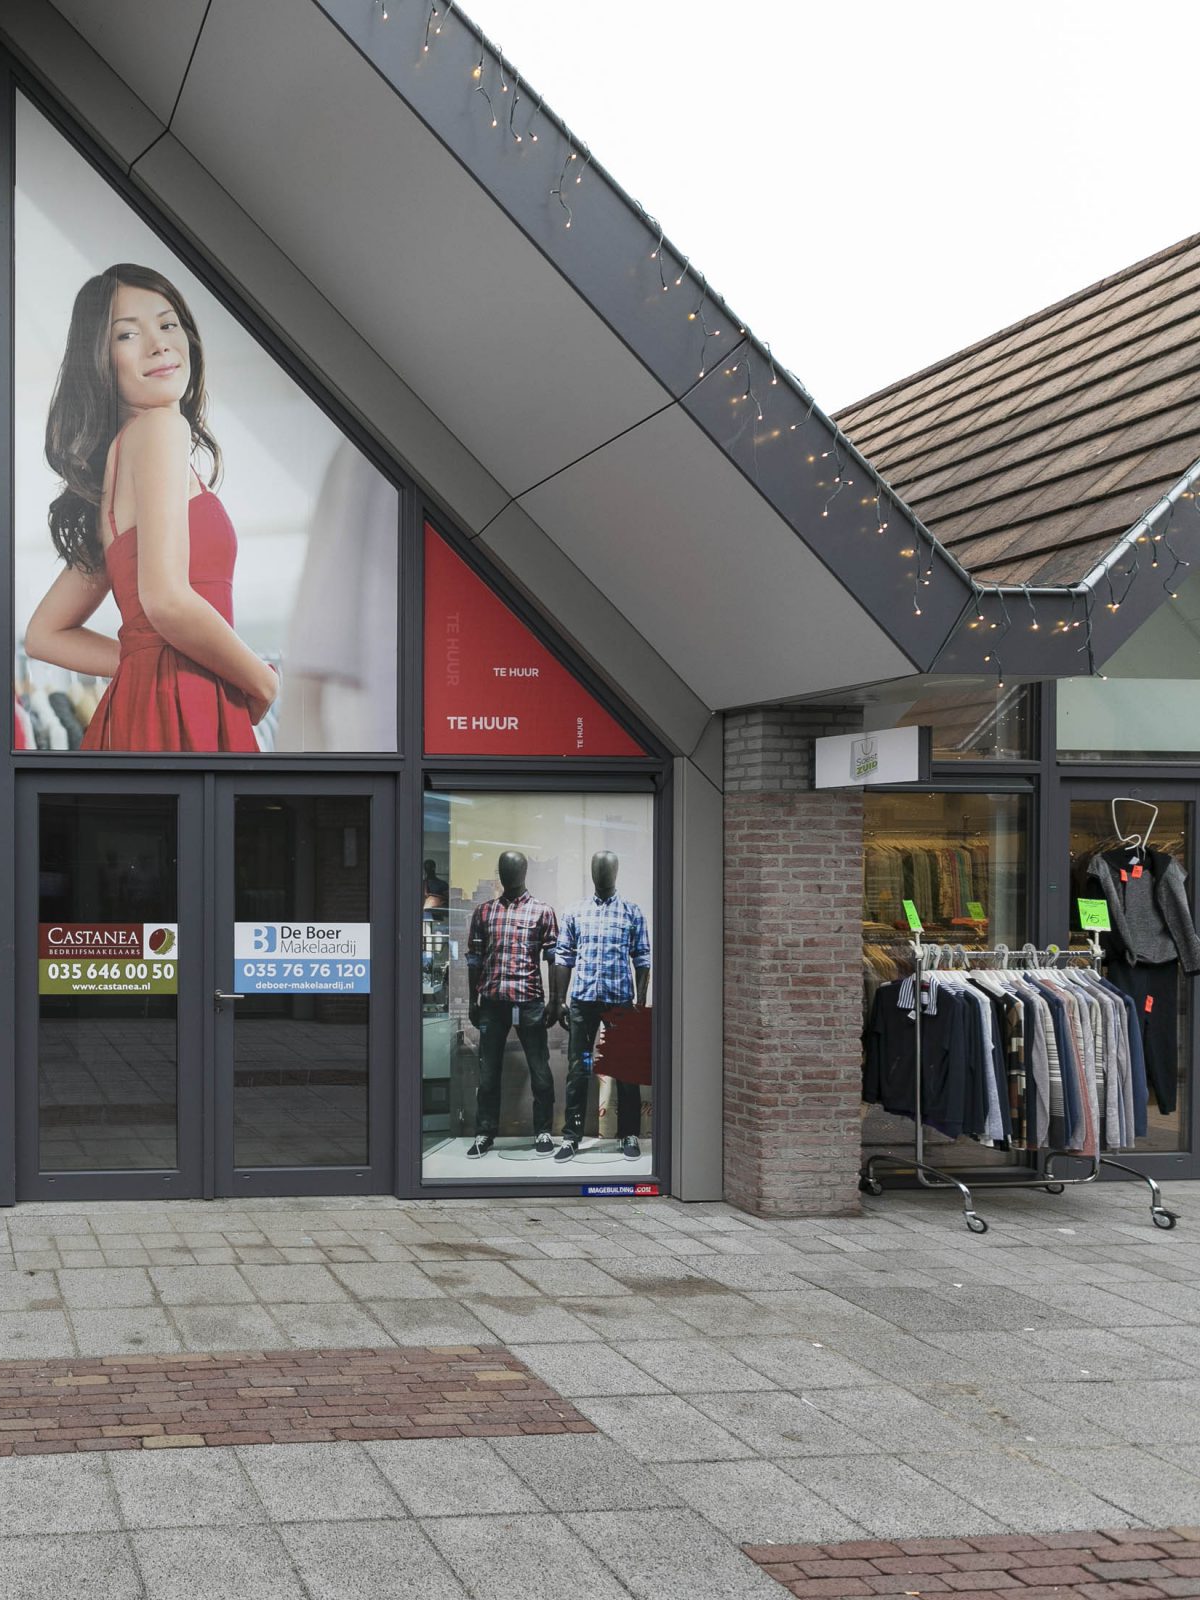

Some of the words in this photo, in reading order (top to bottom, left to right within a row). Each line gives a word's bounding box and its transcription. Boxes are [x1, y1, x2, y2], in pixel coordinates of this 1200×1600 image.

[446, 612, 460, 634] TE
[446, 638, 461, 687] HUUR
[493, 667, 507, 677] TE
[509, 667, 540, 678] HUUR
[446, 716, 468, 730] TE
[471, 716, 519, 731] HUUR
[577, 739, 584, 749] TE
[856, 752, 878, 767] Soest
[856, 760, 878, 775] ZUID
[280, 926, 301, 939] De
[306, 926, 342, 939] Boer
[280, 940, 357, 957] Makelaardij
[47, 963, 82, 980] 035
[86, 963, 120, 980] 646
[125, 963, 148, 980] 00
[152, 963, 175, 980] 50
[243, 963, 277, 977] 035
[282, 963, 304, 977] 76
[309, 963, 331, 977] 76
[336, 963, 366, 977] 120
[72, 982, 151, 991] www.castanea.nl
[255, 981, 355, 991] deboer-makelaardij.nl
